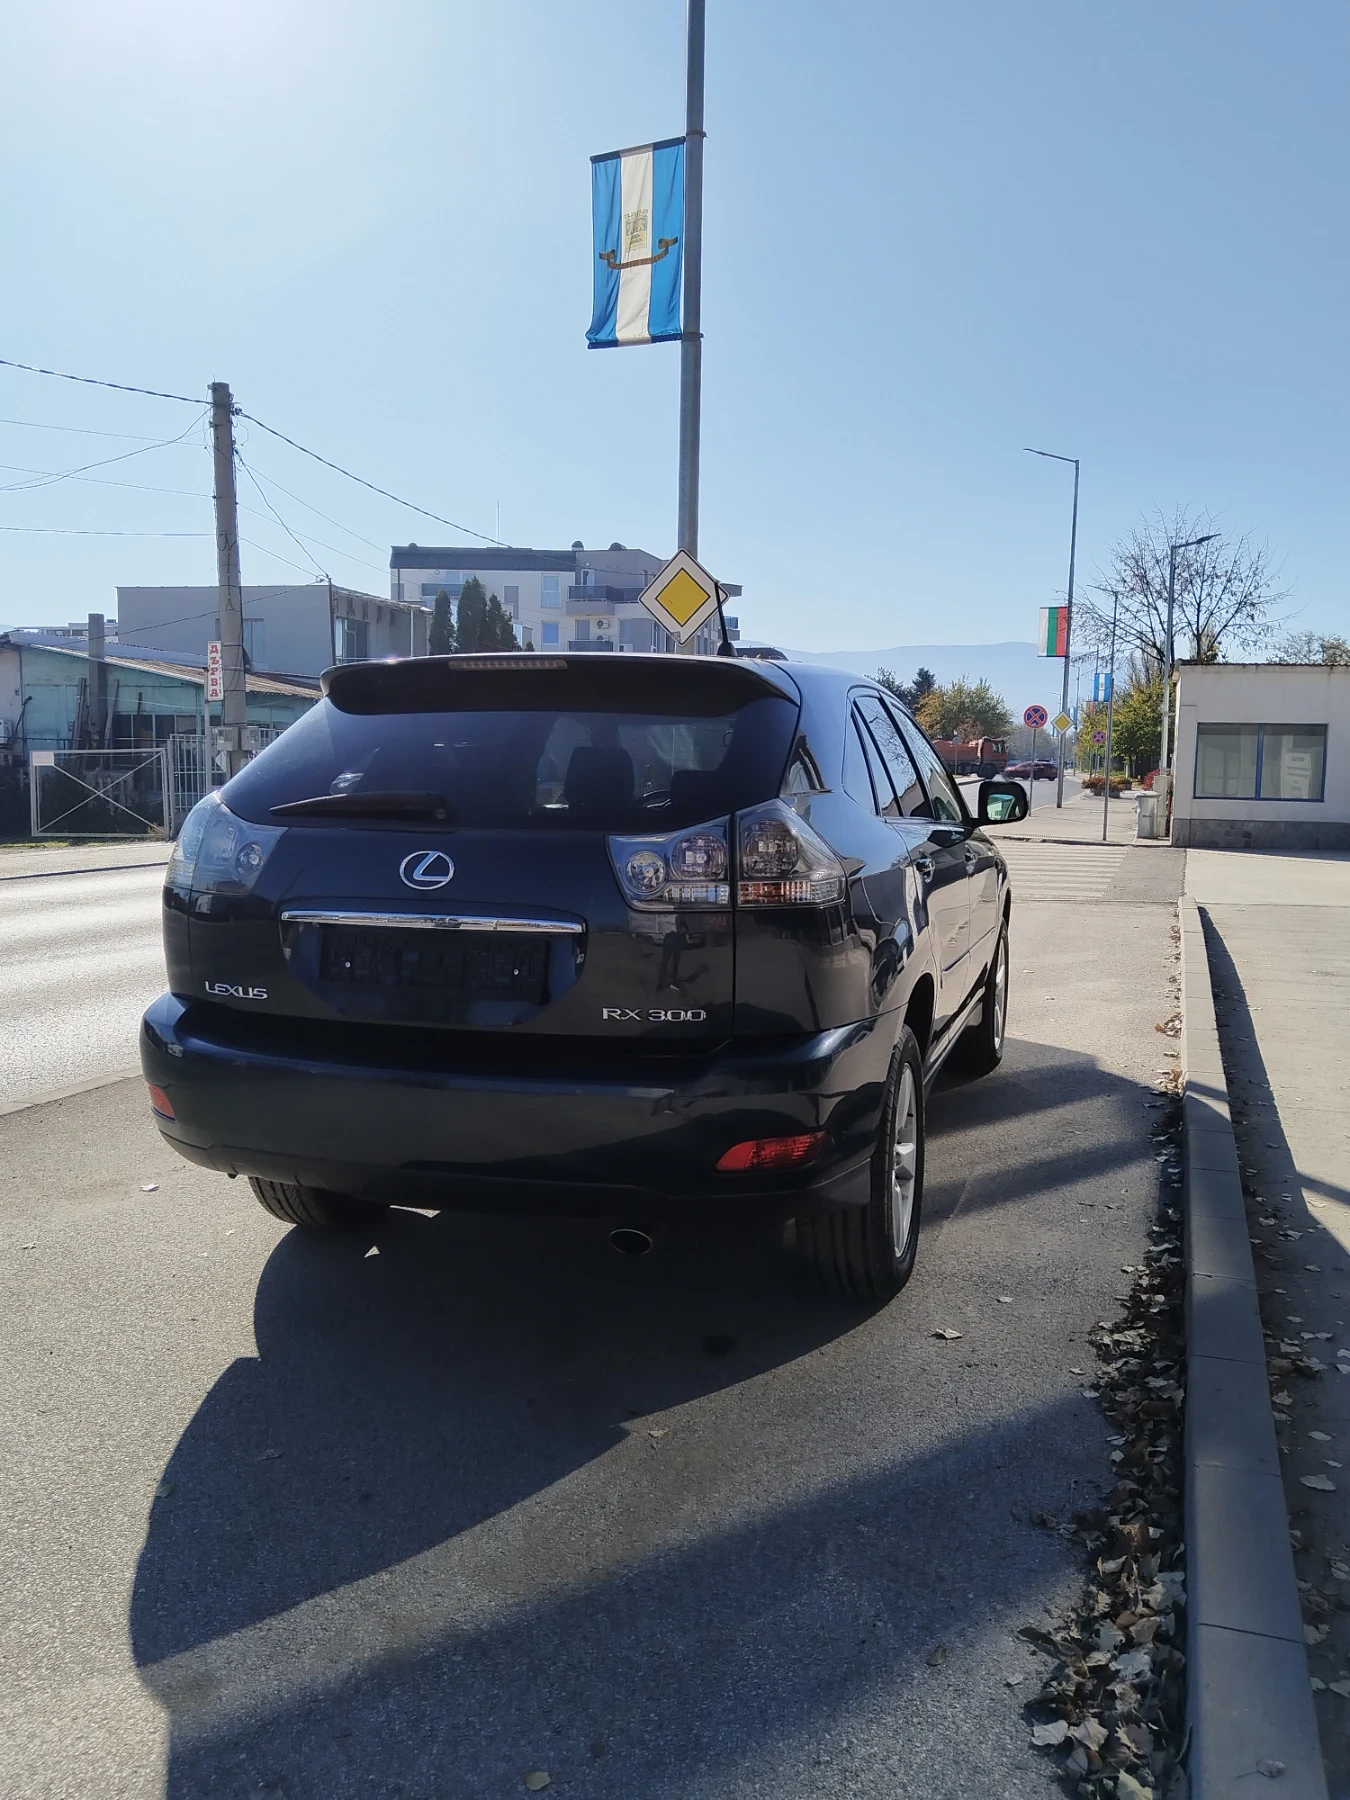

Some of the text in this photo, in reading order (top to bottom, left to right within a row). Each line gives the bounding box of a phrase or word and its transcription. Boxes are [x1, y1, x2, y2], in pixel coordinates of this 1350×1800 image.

[209, 645, 219, 698] ДЪРВА
[204, 980, 268, 1000] LEXUS
[602, 1007, 707, 1022] RX 300
